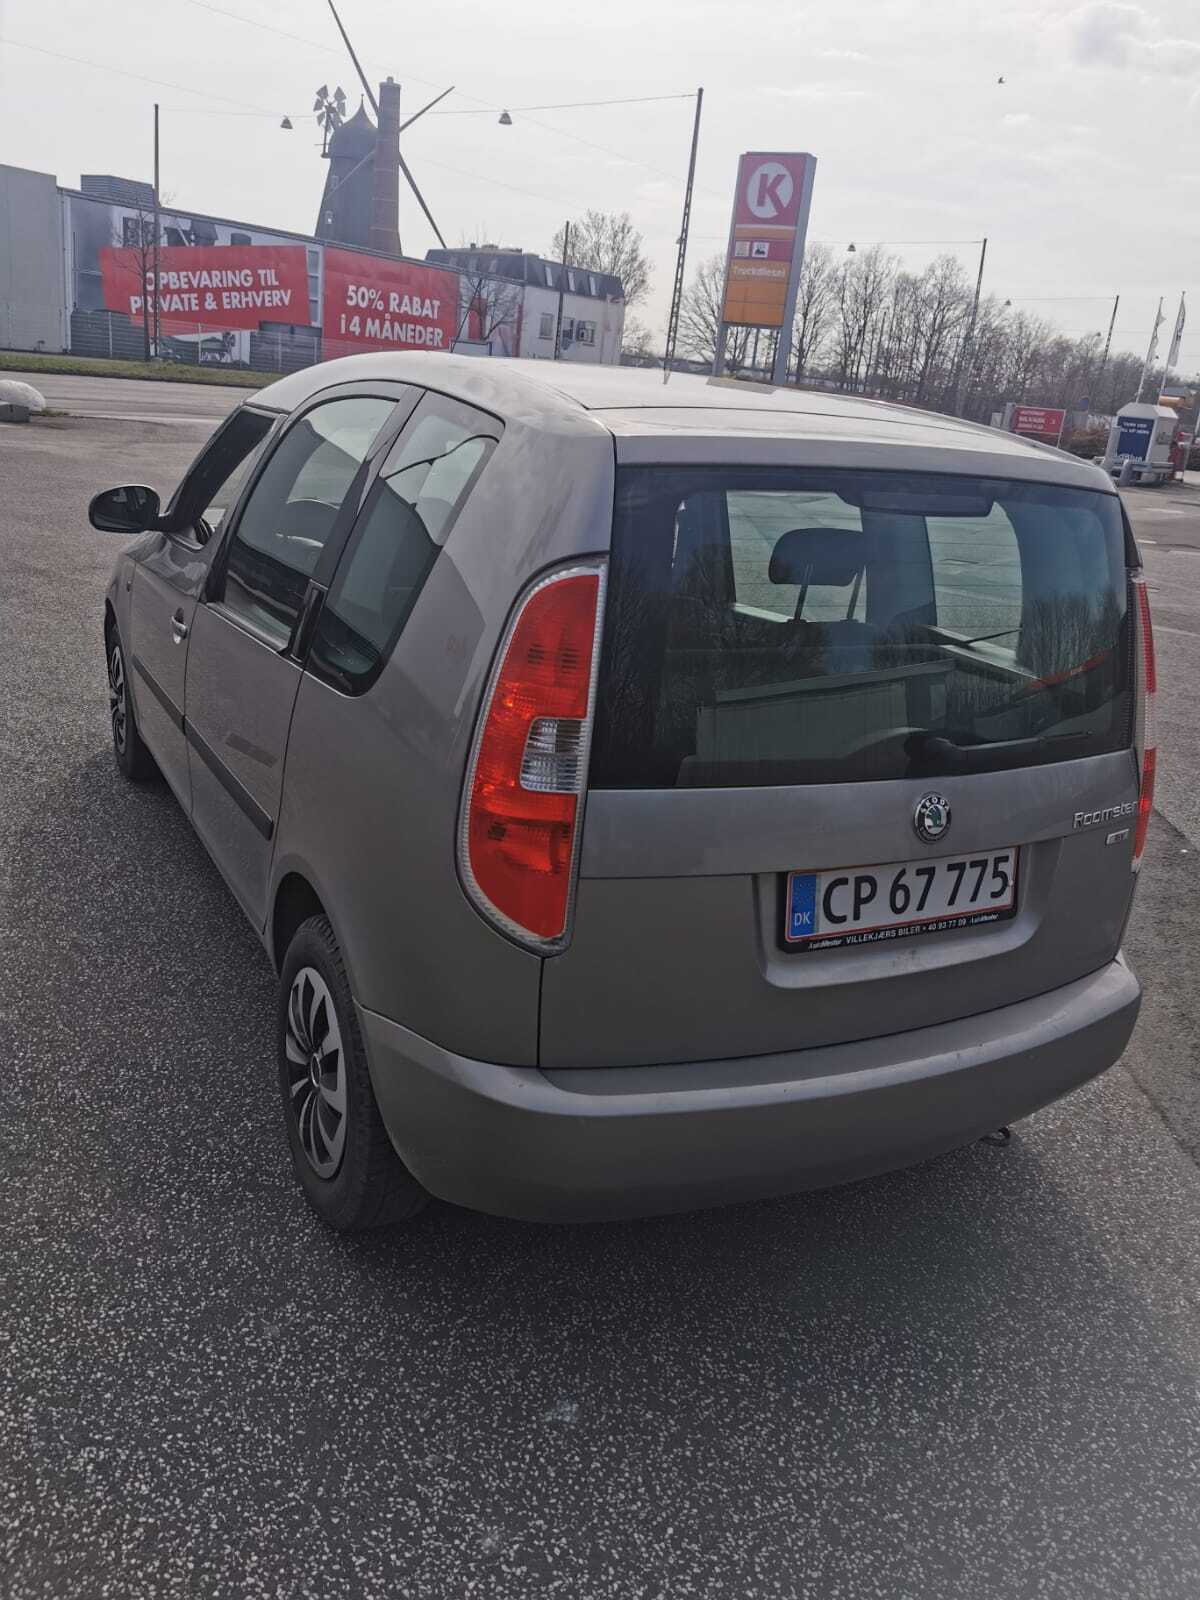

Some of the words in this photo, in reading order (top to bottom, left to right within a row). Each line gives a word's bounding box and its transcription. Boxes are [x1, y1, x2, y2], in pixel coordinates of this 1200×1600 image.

[756, 173, 787, 214] K
[145, 269, 253, 290] OPBEVARING
[257, 269, 279, 286] TIL
[204, 292, 217, 310] &
[222, 289, 291, 309] ERHVERV
[346, 285, 384, 311] 50%
[389, 292, 440, 319] RABAT
[349, 315, 361, 335] 4
[365, 313, 443, 347] MÅNEDER
[1073, 801, 1138, 829] Roomster
[822, 873, 877, 924] CP
[889, 866, 936, 915] 67
[947, 855, 1010, 906] 775
[794, 911, 811, 927] DK
[898, 925, 920, 937] BILER
